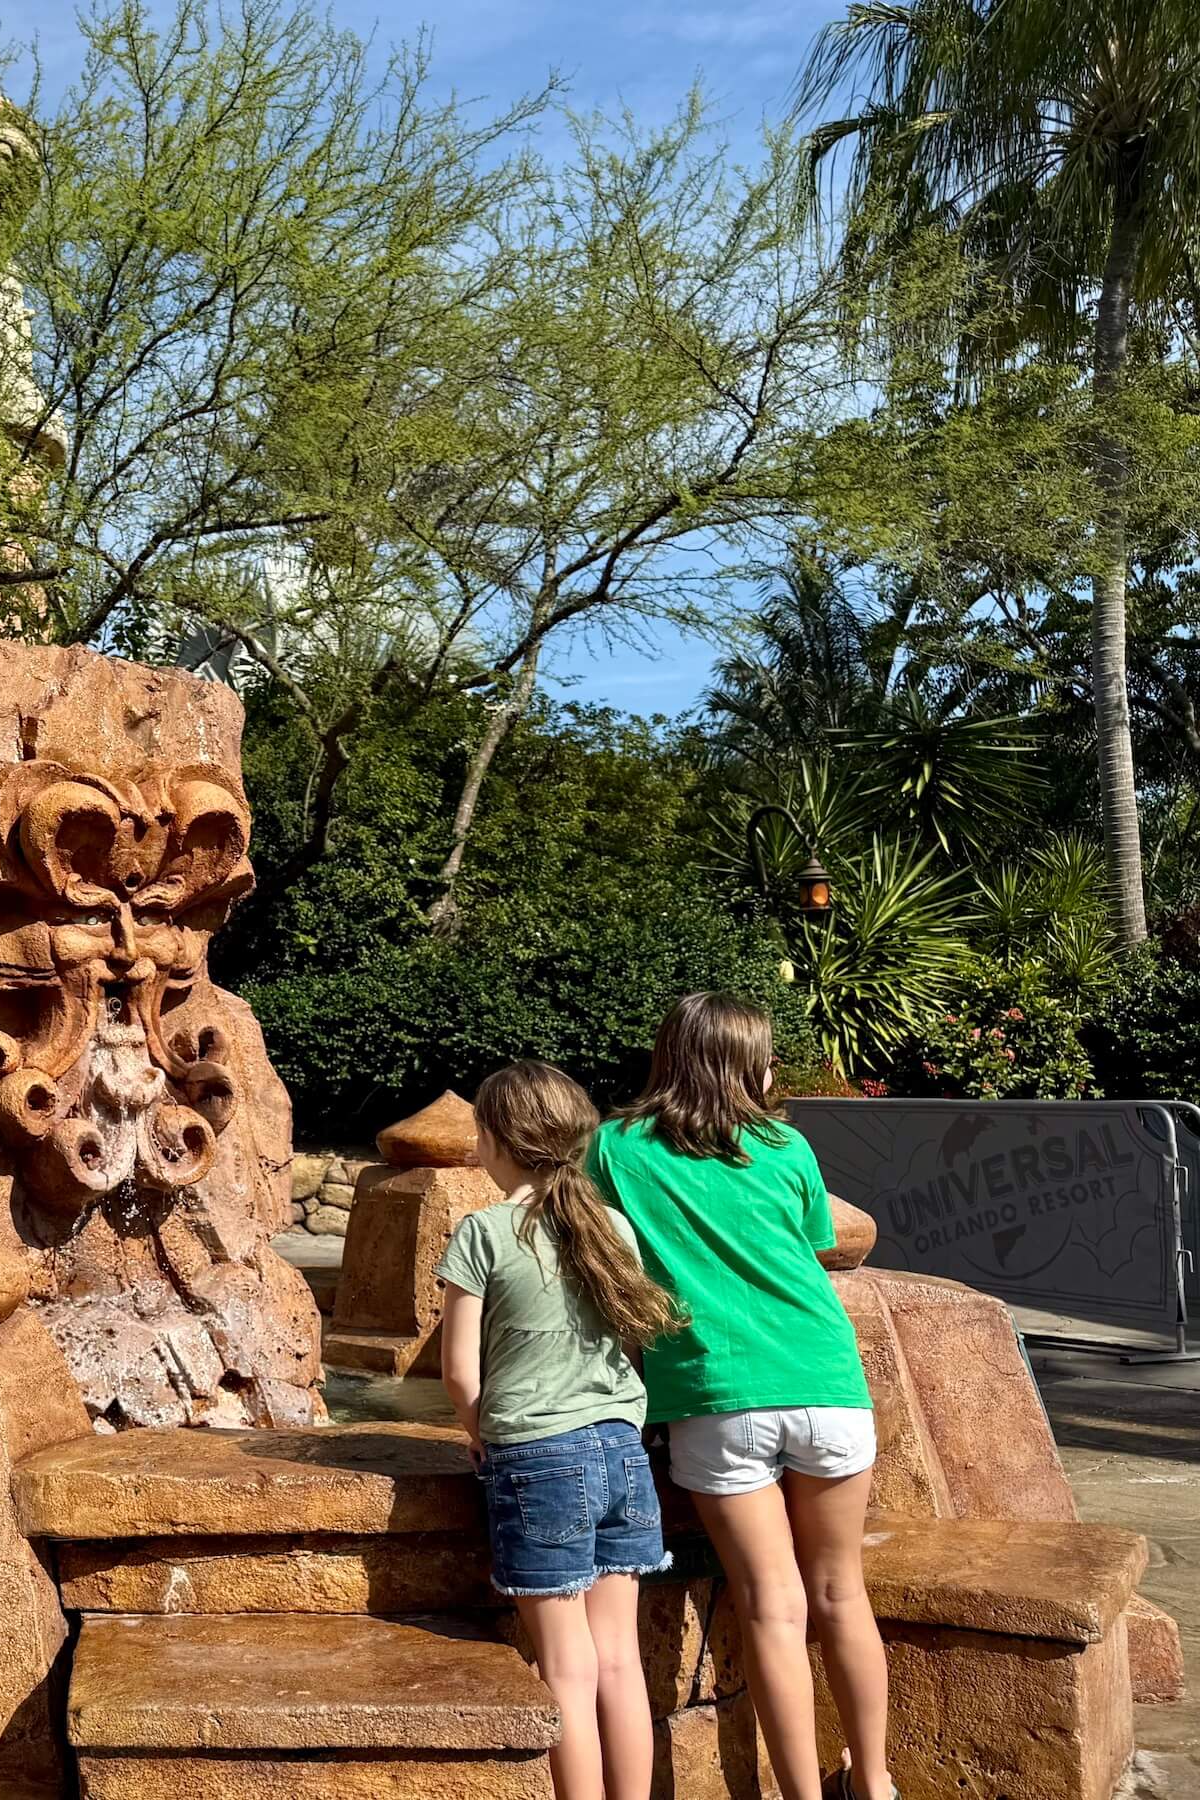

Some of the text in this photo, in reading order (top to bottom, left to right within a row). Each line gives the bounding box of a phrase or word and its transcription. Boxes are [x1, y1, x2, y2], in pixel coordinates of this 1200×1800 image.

[886, 1122, 1135, 1236] UNIVERSAL
[914, 1175, 1117, 1254] ORLANDO RESORT
